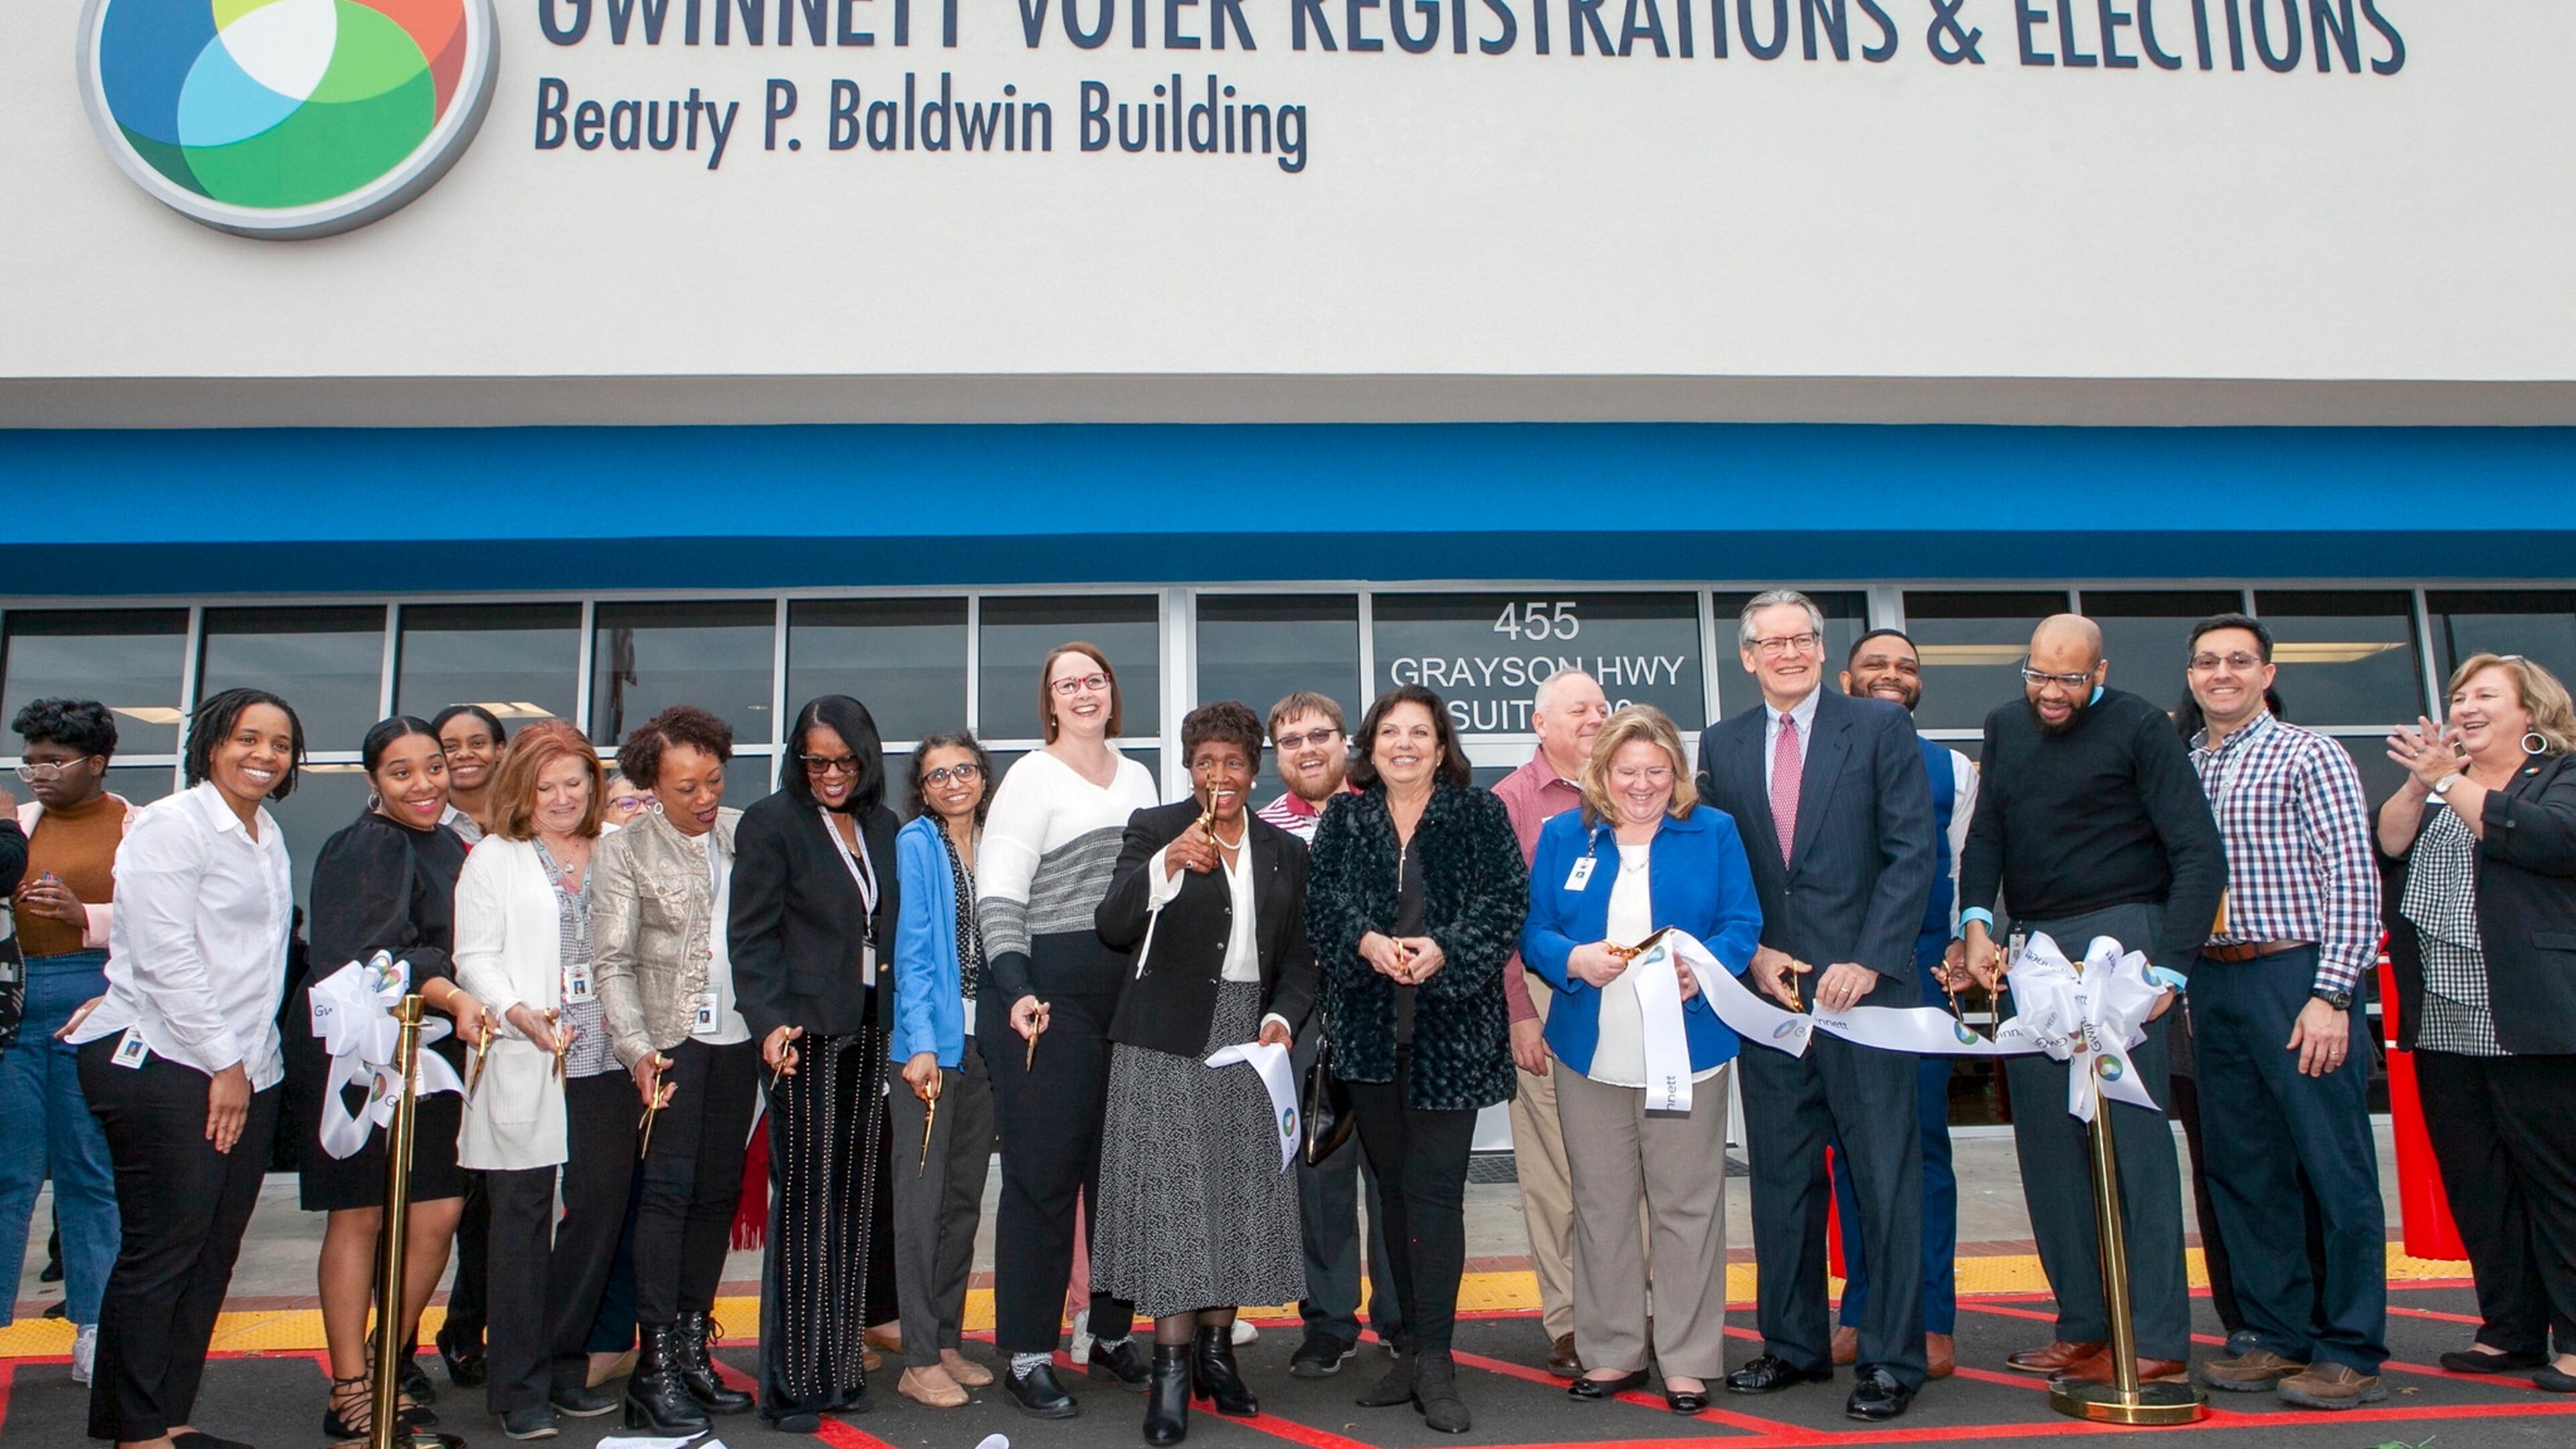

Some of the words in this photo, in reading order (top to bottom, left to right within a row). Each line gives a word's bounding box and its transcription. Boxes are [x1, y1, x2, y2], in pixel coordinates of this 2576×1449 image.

[1927, 0, 1986, 65] &
[2013, 0, 2407, 76] ELECTIONS
[534, 76, 741, 171] Beauty
[763, 78, 802, 152] P.
[828, 72, 1053, 153] Baldwin
[1079, 73, 1307, 174] Building
[1493, 602, 1580, 641] 455
[1597, 655, 1685, 686] HWY
[1447, 699, 1534, 731] SUIT
